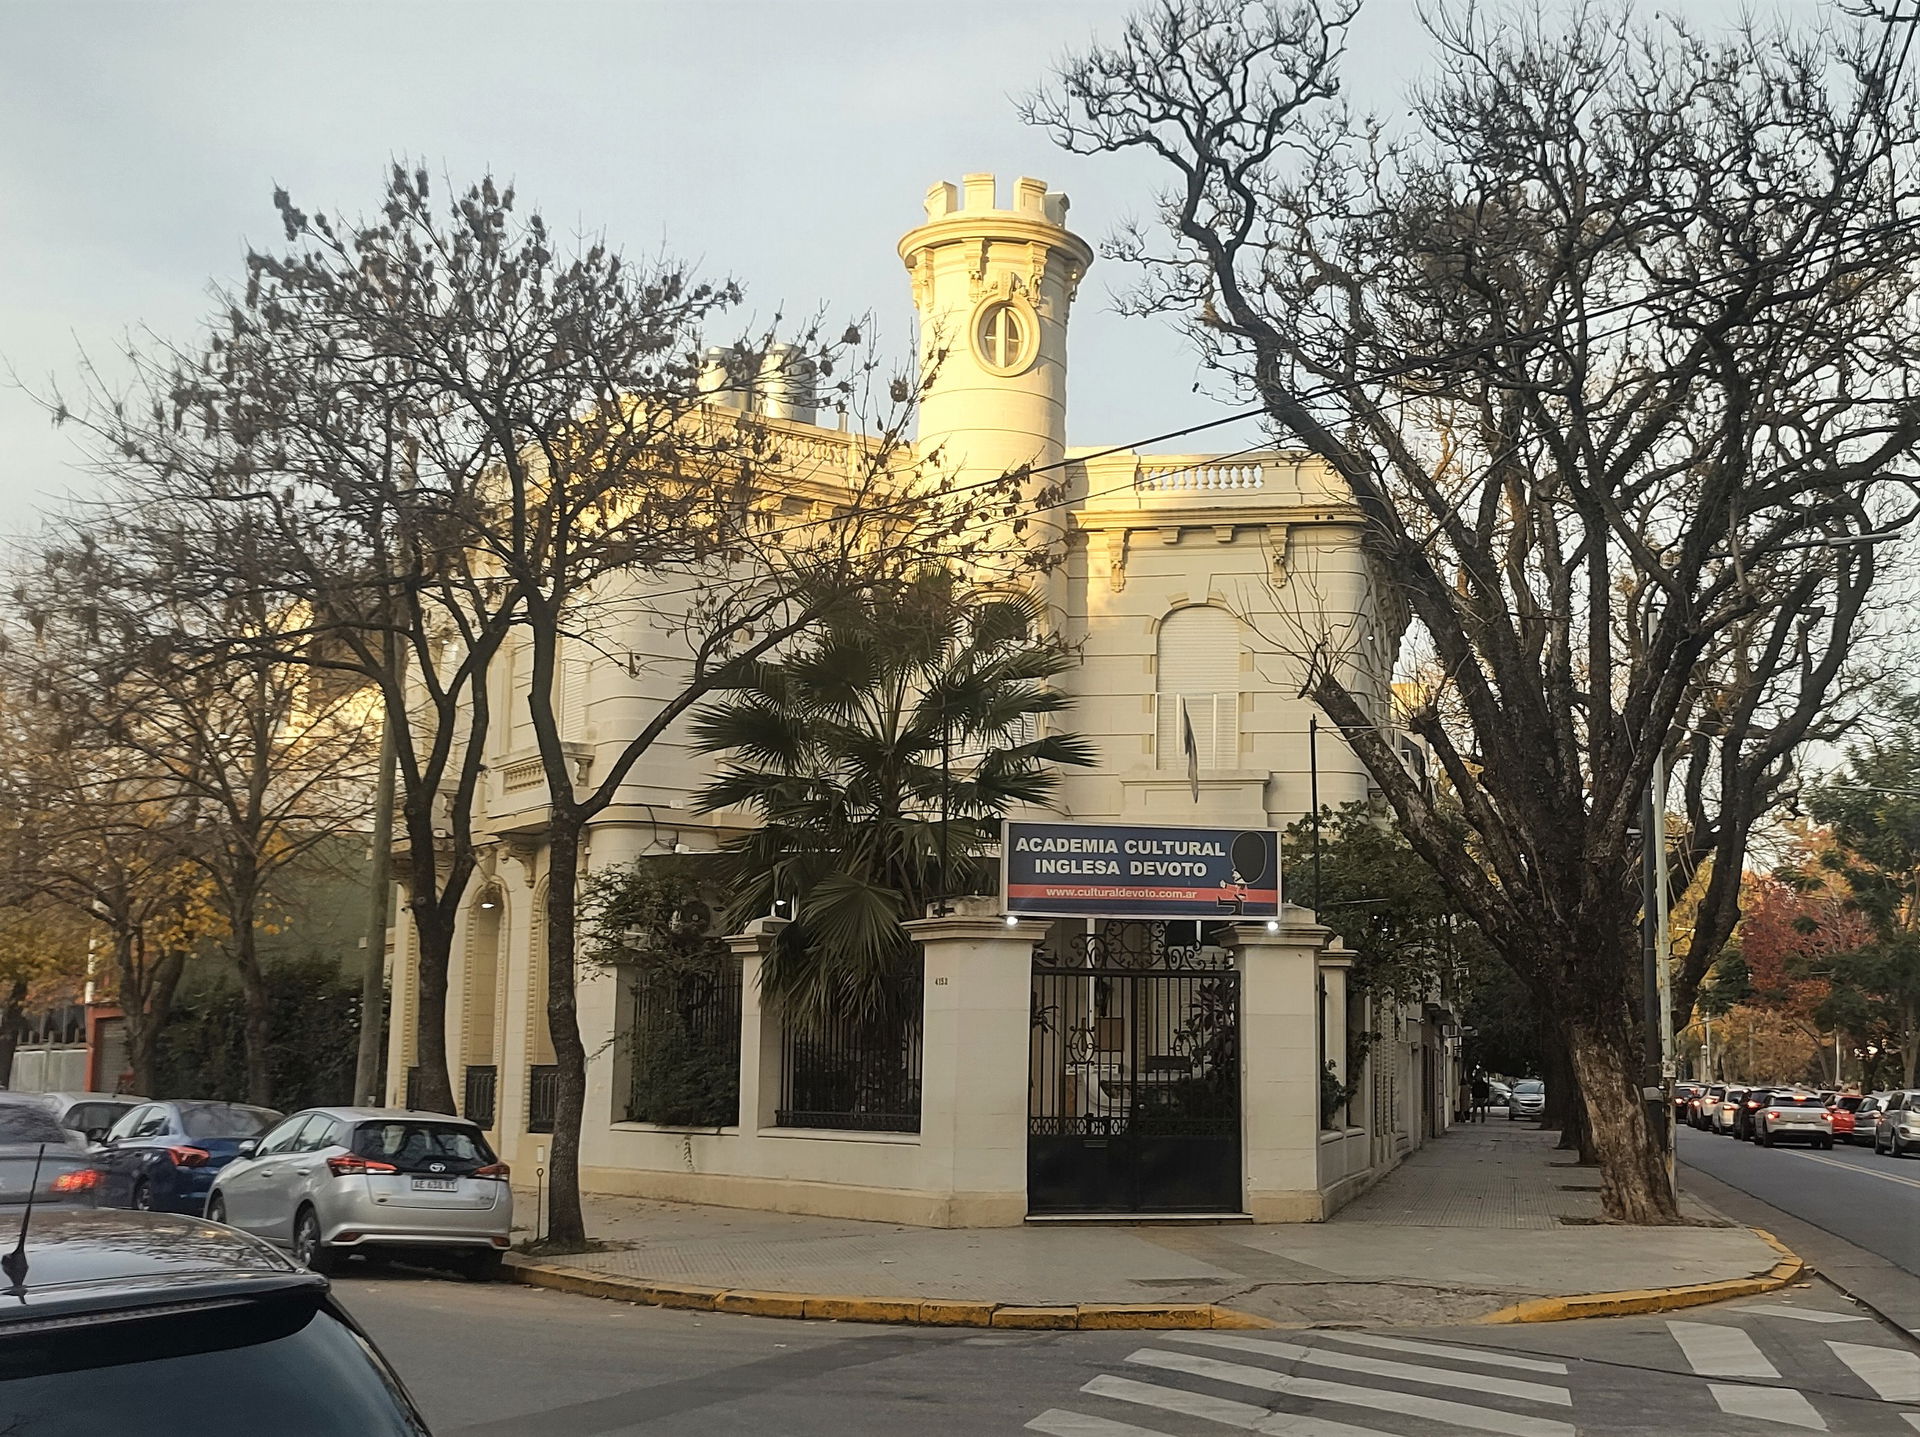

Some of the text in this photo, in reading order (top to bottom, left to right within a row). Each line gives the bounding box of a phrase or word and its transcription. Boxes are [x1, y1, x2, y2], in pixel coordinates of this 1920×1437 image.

[1015, 837, 1226, 857] ACADEMIA CULTURAL
[1034, 859, 1208, 877] INGLESA DEVOTO
[1046, 886, 1198, 900] www.culturaldevoto.com.ar
